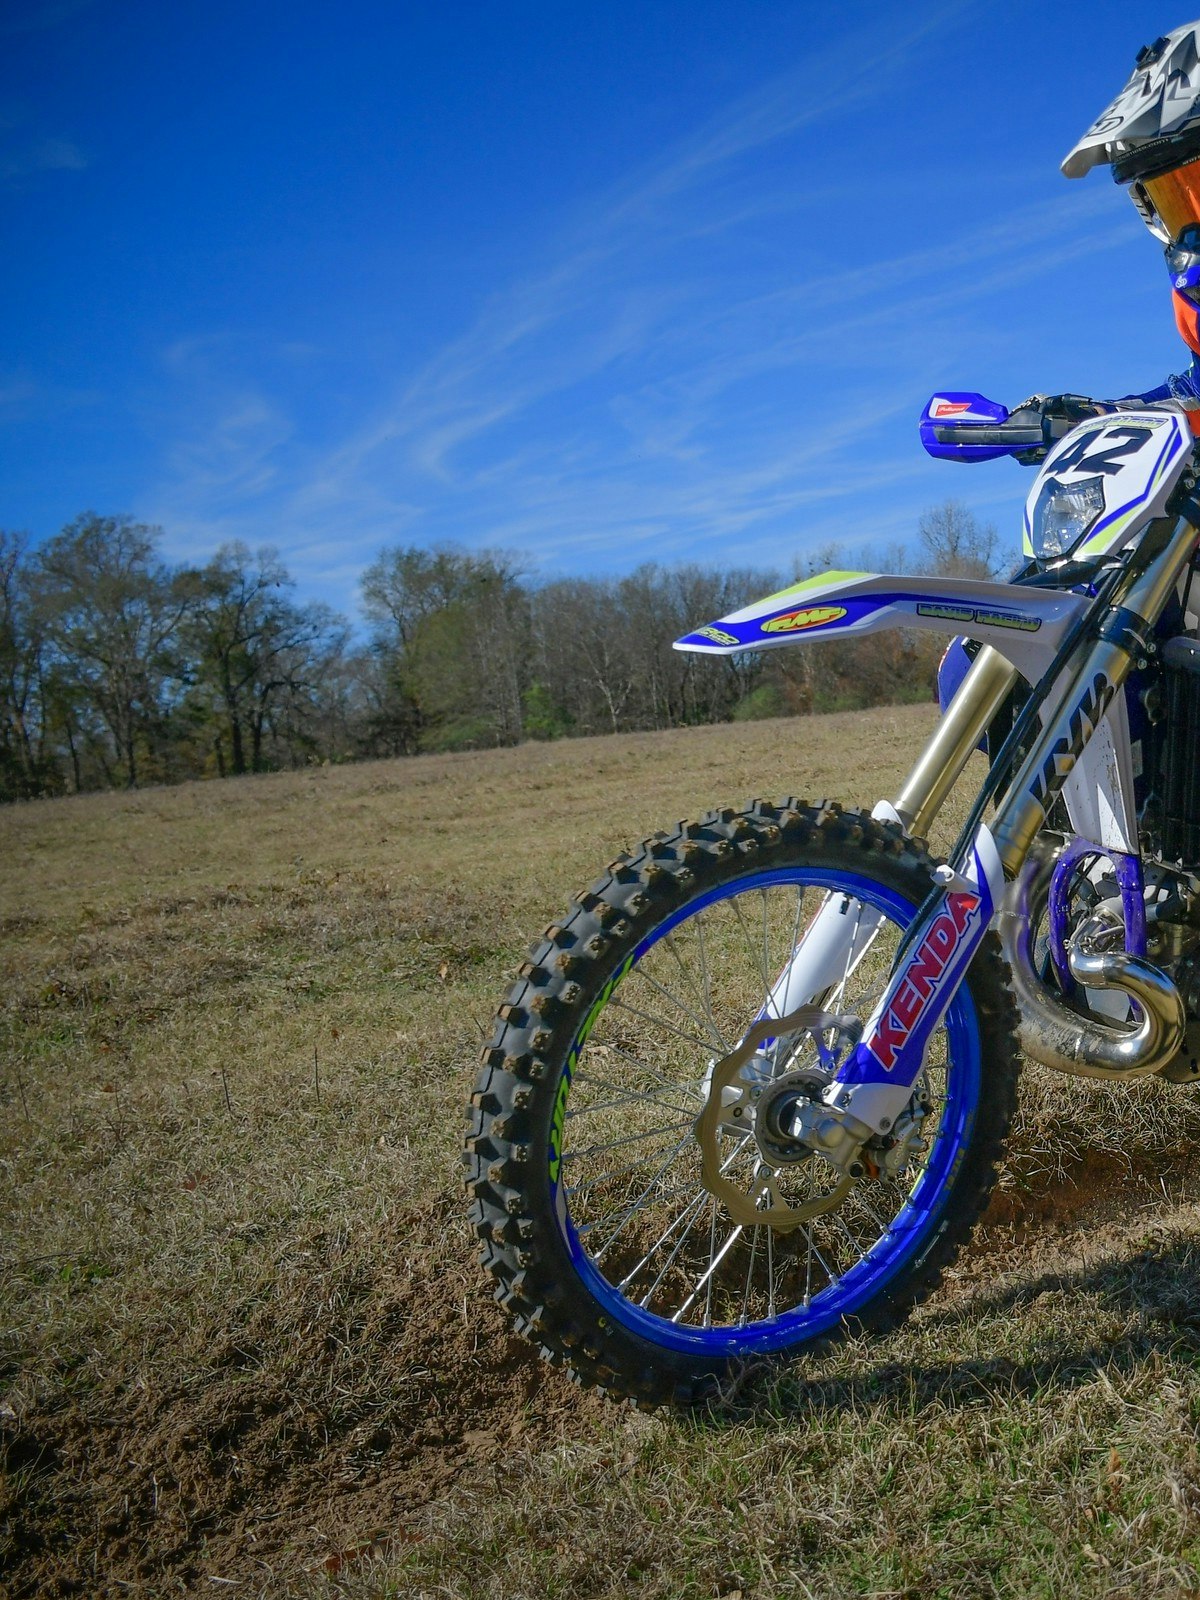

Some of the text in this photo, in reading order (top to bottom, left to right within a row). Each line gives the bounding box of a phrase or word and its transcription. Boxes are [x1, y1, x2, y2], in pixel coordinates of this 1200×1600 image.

[1041, 427, 1153, 477] 42
[766, 607, 843, 633] FMF
[1029, 673, 1115, 813] KYB
[867, 892, 982, 1072] KENDA
